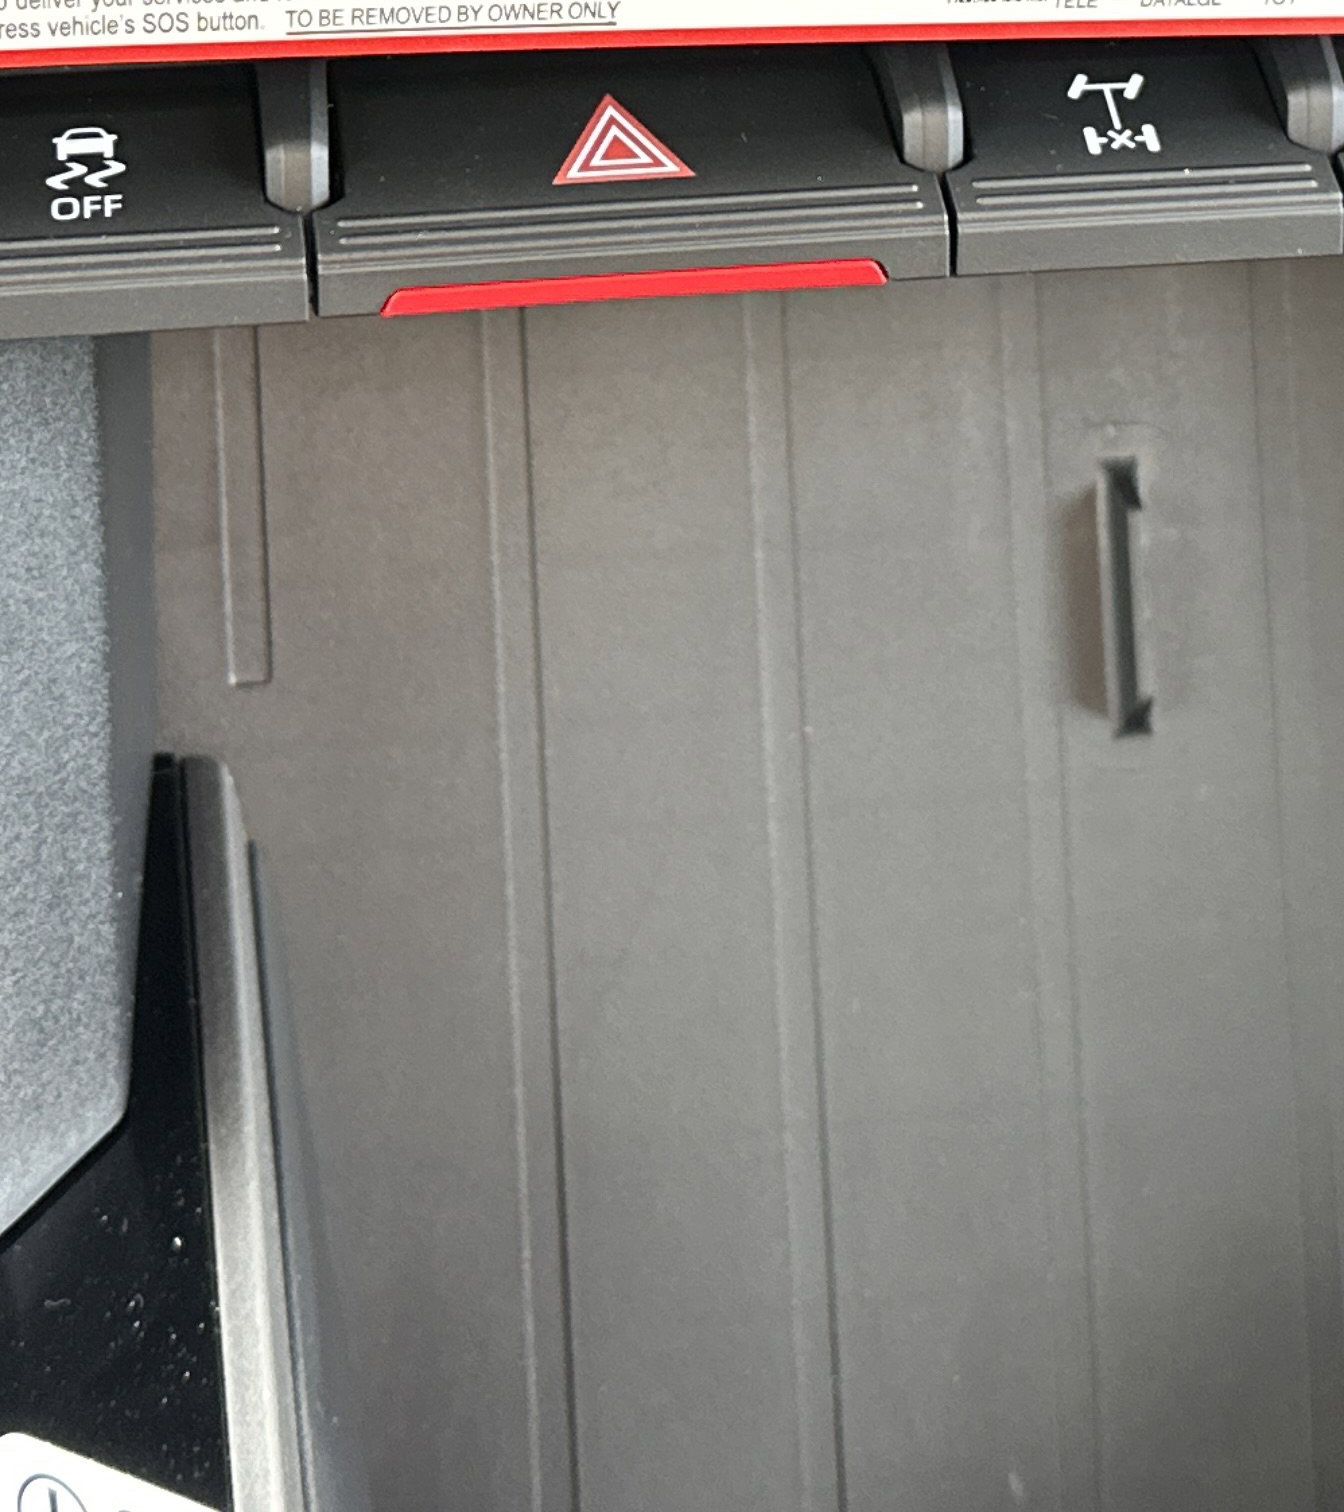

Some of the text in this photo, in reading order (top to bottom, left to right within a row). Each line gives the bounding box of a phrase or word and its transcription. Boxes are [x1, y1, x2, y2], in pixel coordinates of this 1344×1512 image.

[47, 13, 136, 37] vehicle's
[142, 11, 190, 34] SOS
[196, 10, 265, 32] button.
[285, 9, 313, 28] TO
[318, 8, 345, 27] BE
[351, 5, 452, 26] REMOVED
[456, 4, 483, 23] BY
[487, 1, 564, 22] OWNER
[567, 0, 621, 20] ONLY
[49, 193, 124, 222] OFF
